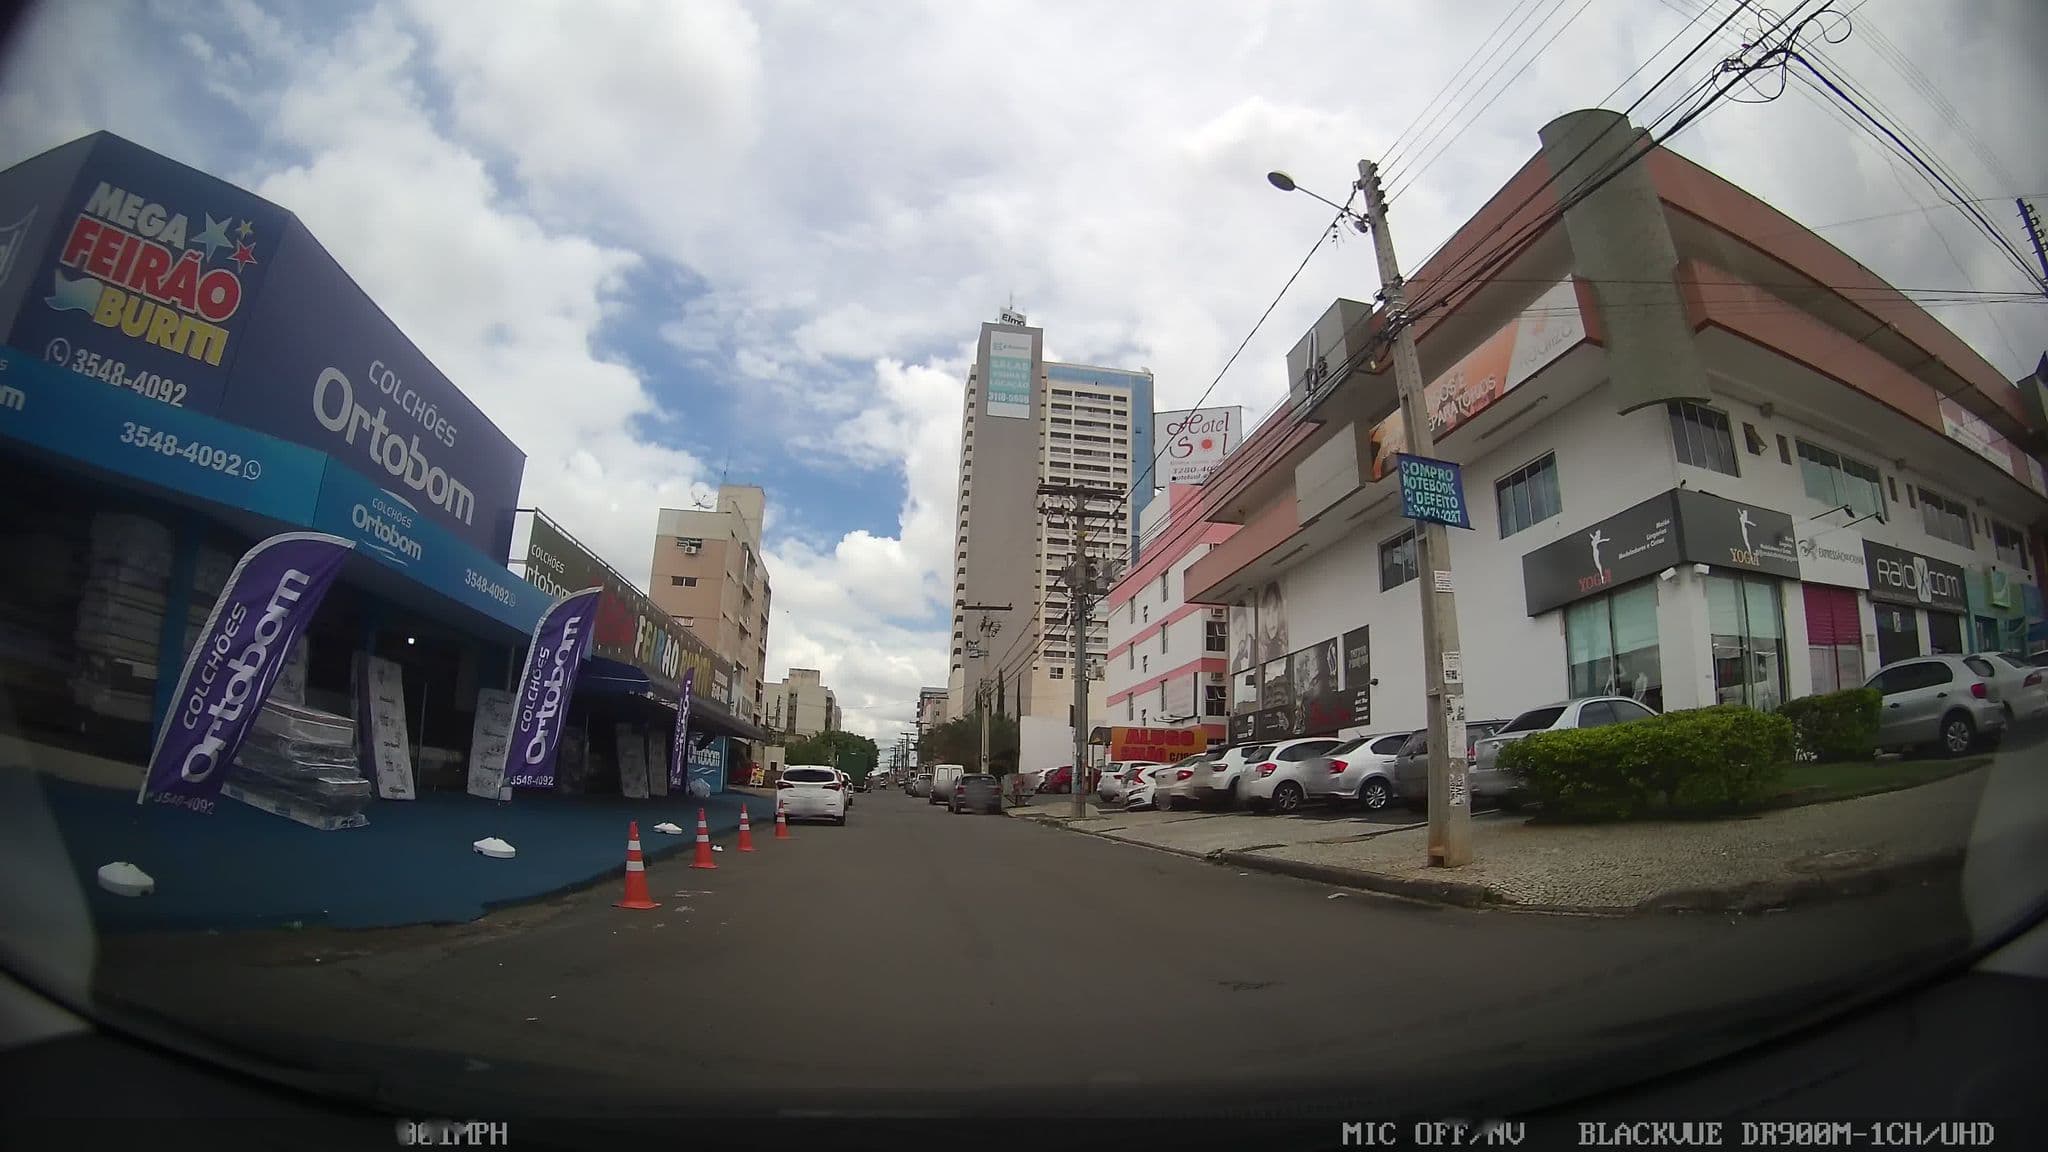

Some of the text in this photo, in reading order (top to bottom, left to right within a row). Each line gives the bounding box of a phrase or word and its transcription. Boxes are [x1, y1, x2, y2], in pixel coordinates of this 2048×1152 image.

[85, 181, 189, 249] MEGA
[60, 214, 242, 322] FEIRÃO
[93, 286, 230, 366] BURITI
[72, 349, 188, 408] 3548-4092
[369, 360, 457, 448] COLCHÕES
[120, 421, 243, 476] 3548-4092
[313, 366, 475, 526] Ortobom
[1401, 460, 1453, 482] COMPRO
[371, 497, 413, 529] COLCHÕES
[1402, 474, 1456, 495] NOTEBOOK
[1416, 491, 1459, 509] DEFEITO
[351, 503, 422, 560] Ortobom
[531, 544, 566, 574] COLCHÕES
[464, 567, 511, 606] 3548-4092
[524, 564, 572, 600] rtobom
[181, 568, 311, 784] Ortobom
[182, 602, 248, 731] COLCHÕES
[633, 614, 681, 680] FEIRÃO
[520, 646, 550, 733] COLCHÕES
[525, 615, 582, 765] Ortobom
[1125, 728, 1196, 746] ALUGO
